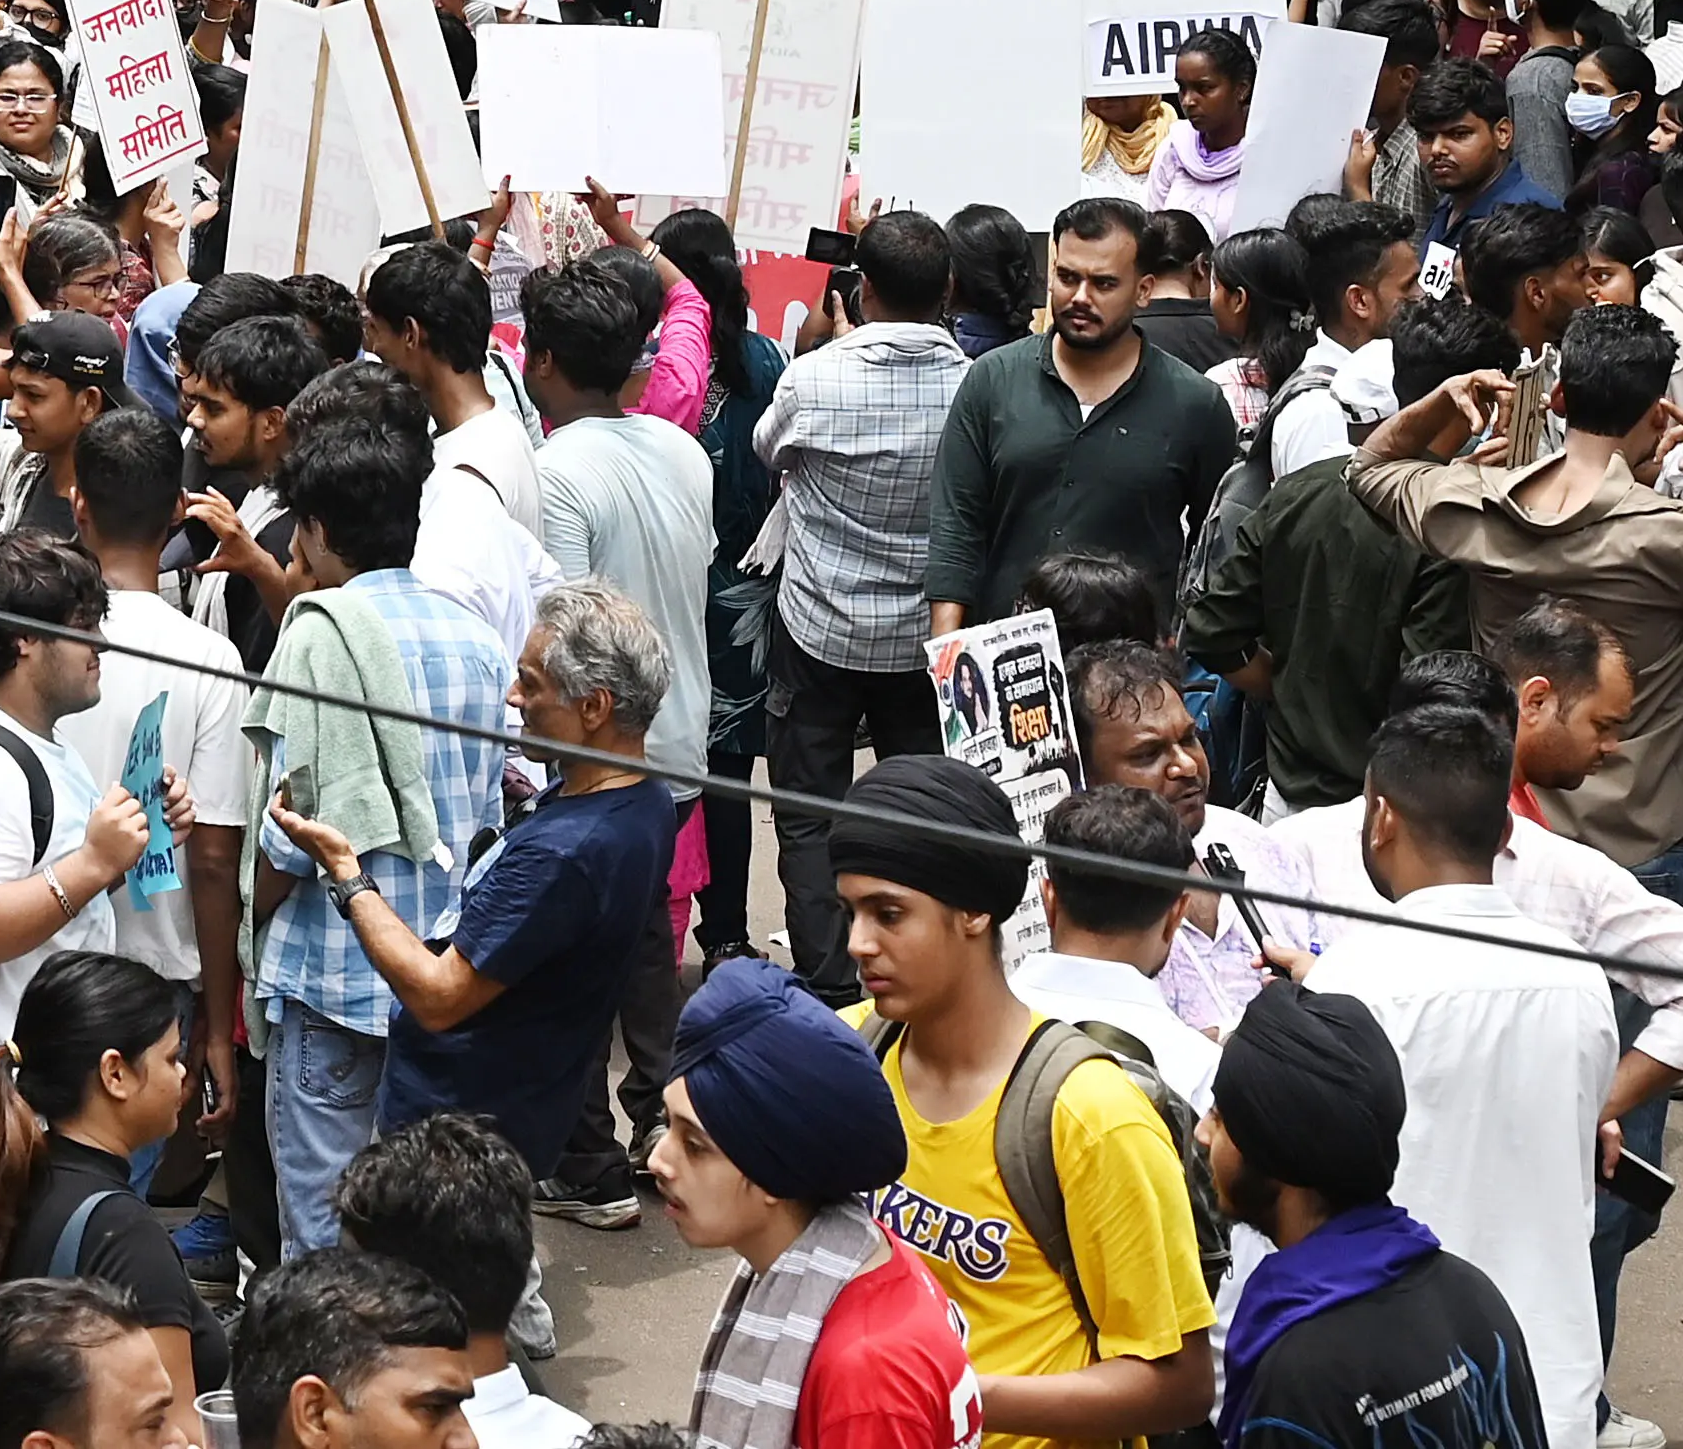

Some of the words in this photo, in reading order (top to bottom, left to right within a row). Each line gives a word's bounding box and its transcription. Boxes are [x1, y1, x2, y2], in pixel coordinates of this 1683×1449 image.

[106, 50, 172, 101] महिला
[119, 104, 187, 163] समिति
[1010, 702, 1051, 745] शिक्षा
